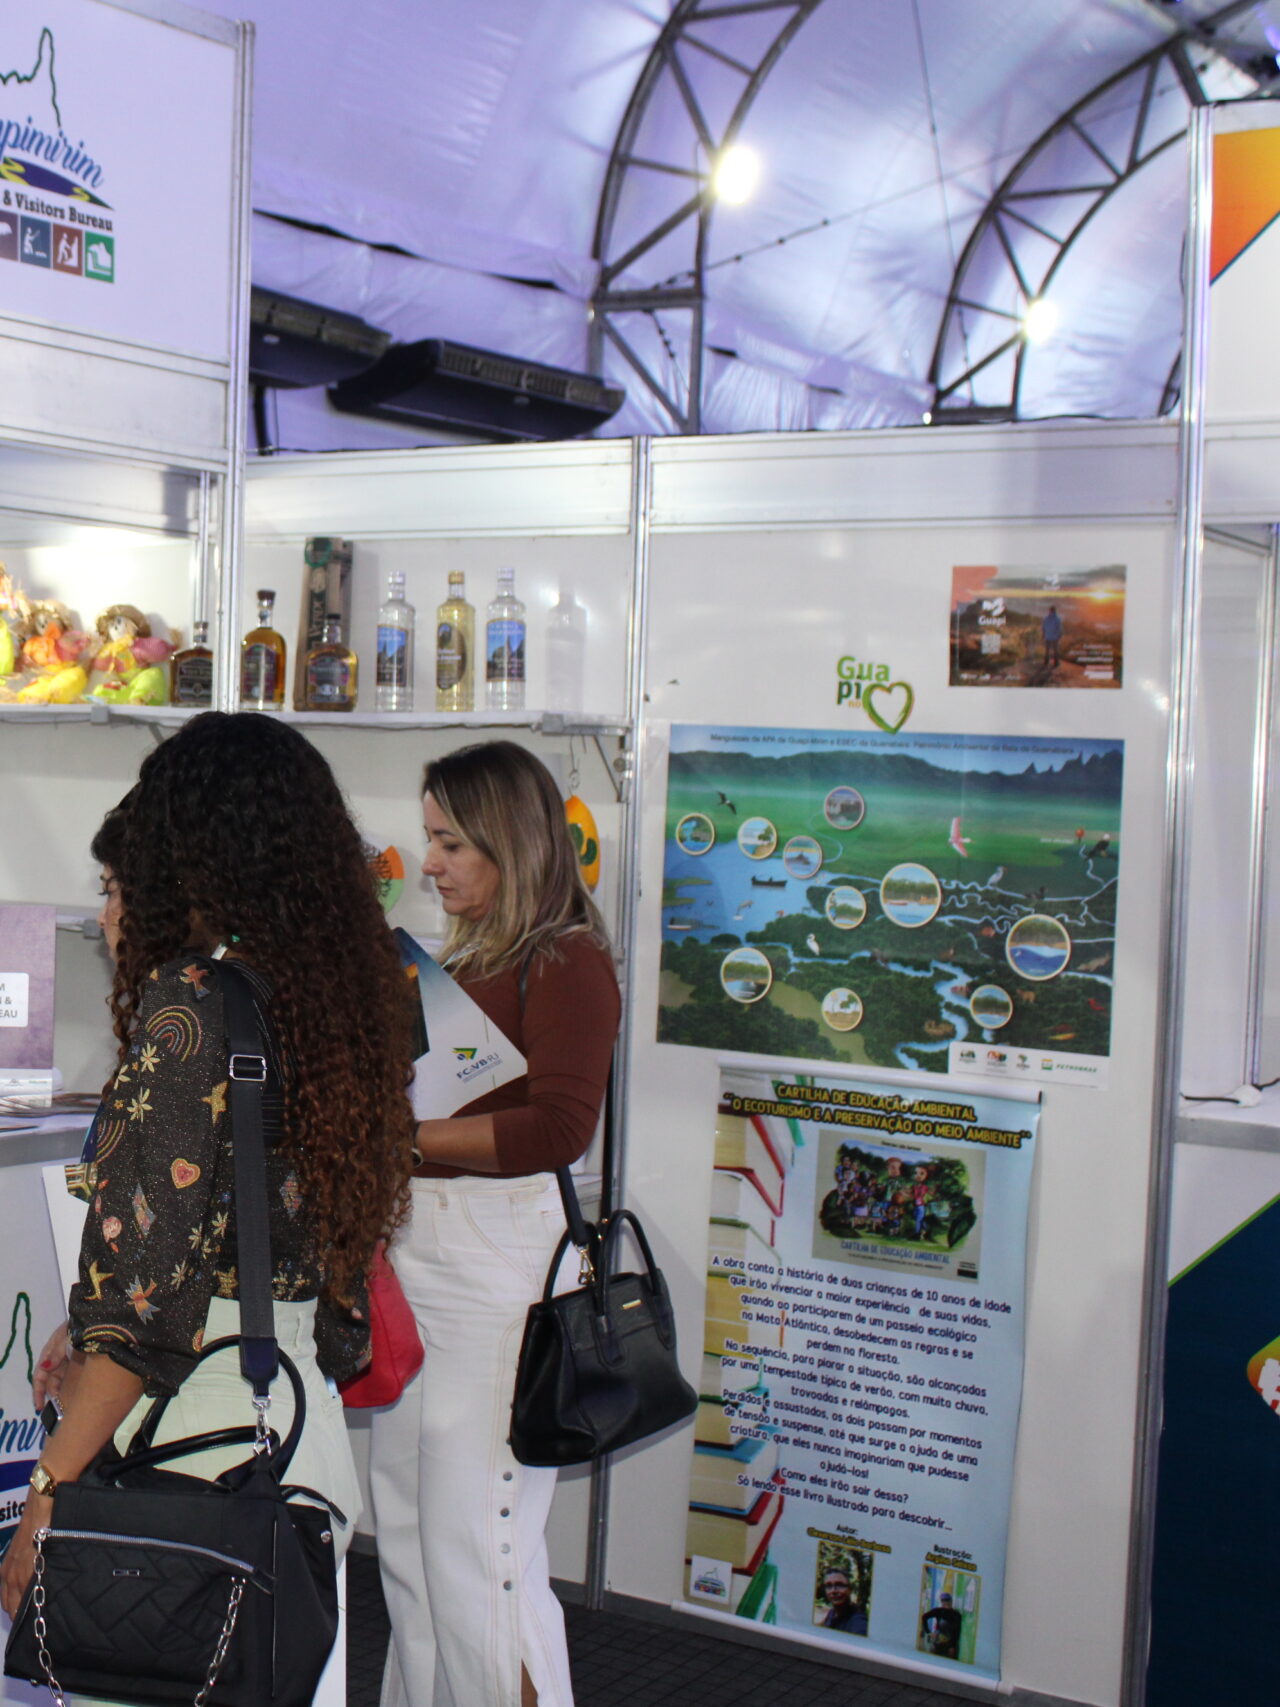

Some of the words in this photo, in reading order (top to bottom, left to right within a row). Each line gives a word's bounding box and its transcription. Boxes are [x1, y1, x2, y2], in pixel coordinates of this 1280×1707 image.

[3, 190, 12, 204] &
[15, 192, 65, 220] Visitors
[69, 206, 112, 231] Bureau
[837, 656, 890, 681] Gua
[837, 681, 861, 705] pi
[4, 996, 12, 1005] &
[744, 1099, 811, 1119] ECOTURISMO
[814, 1108, 820, 1119] E
[823, 1110, 832, 1122] A
[836, 1111, 911, 1132] PRESERVAÇÃO
[915, 1122, 932, 1135] DO
[936, 1124, 963, 1139] MEIO
[778, 1085, 830, 1101] CARTILHA
[833, 1091, 846, 1104] DE
[849, 1093, 909, 1114] EDUCAÇÃO
[912, 1102, 976, 1121] AMBIENTAL
[713, 1256, 720, 1265] A
[723, 1258, 745, 1270] obra
[748, 1261, 774, 1274] conta
[778, 1268, 783, 1276] a
[786, 1267, 823, 1282] história
[827, 1275, 838, 1285] de
[841, 1276, 863, 1289] duas
[866, 1281, 907, 1298] crianças
[911, 1288, 923, 1299] de
[926, 1290, 938, 1301] 10
[942, 1293, 966, 1306] anos
[969, 1297, 981, 1308] de
[983, 1299, 1011, 1313] idade
[730, 1275, 746, 1287] que
[749, 1276, 768, 1290] irão
[771, 1282, 813, 1298] vivenciar
[817, 1290, 823, 1298] a
[825, 1291, 852, 1304] maior
[855, 1296, 910, 1315] experiência
[919, 1307, 931, 1318] de
[935, 1310, 958, 1322] suas
[741, 1294, 774, 1308] quando
[778, 1301, 790, 1310] ao
[792, 1302, 852, 1321] participarem
[855, 1313, 866, 1324] de
[870, 1317, 883, 1327] um
[886, 1319, 924, 1335] passeio
[928, 1327, 977, 1343] ecológico
[742, 1310, 753, 1321] na
[756, 1311, 781, 1325] Mata
[833, 1326, 898, 1346] desobedecem
[900, 1340, 912, 1350] as
[915, 1343, 949, 1355] regras
[952, 1348, 958, 1357] e
[962, 1350, 973, 1360] se
[726, 1340, 738, 1351] Na
[792, 1354, 815, 1366] para
[848, 1365, 854, 1373] a
[906, 1375, 925, 1386] são
[928, 1378, 987, 1397] alcançadas
[806, 1339, 841, 1354] perdem
[843, 1345, 855, 1356] na
[721, 1356, 737, 1367] por
[740, 1360, 759, 1372] uma
[763, 1363, 818, 1383] tempestade
[850, 1381, 861, 1391] de
[898, 1390, 920, 1402] com
[922, 1395, 951, 1408] muita
[791, 1385, 839, 1405] trovoadas
[842, 1398, 847, 1406] e
[723, 1388, 761, 1405] Perdidos
[764, 1399, 770, 1408] e
[846, 1414, 865, 1427] dois
[869, 1418, 907, 1434] passam
[909, 1428, 926, 1439] por
[929, 1431, 982, 1449] momentos
[724, 1406, 735, 1416] de
[738, 1409, 770, 1423] tensão
[773, 1416, 778, 1425] e
[829, 1428, 845, 1440] até
[848, 1433, 865, 1444] que
[869, 1437, 896, 1450] surge
[899, 1443, 906, 1451] a
[941, 1450, 953, 1461] de
[957, 1455, 978, 1466] uma
[773, 1433, 790, 1445] que
[792, 1437, 811, 1449] eles
[813, 1442, 841, 1456] nunca
[844, 1447, 905, 1468] imaginariam
[907, 1461, 925, 1473] que
[928, 1465, 969, 1482] pudesse
[737, 1474, 749, 1485] Só
[752, 1477, 777, 1492] lendo
[780, 1486, 800, 1498] esse
[803, 1489, 824, 1503] livro
[827, 1494, 869, 1512] ilustrado
[871, 1506, 895, 1518] para
[780, 1467, 807, 1482] Como
[809, 1474, 828, 1487] eles
[852, 1485, 870, 1496] sair
[874, 1488, 908, 1503] dessa?
